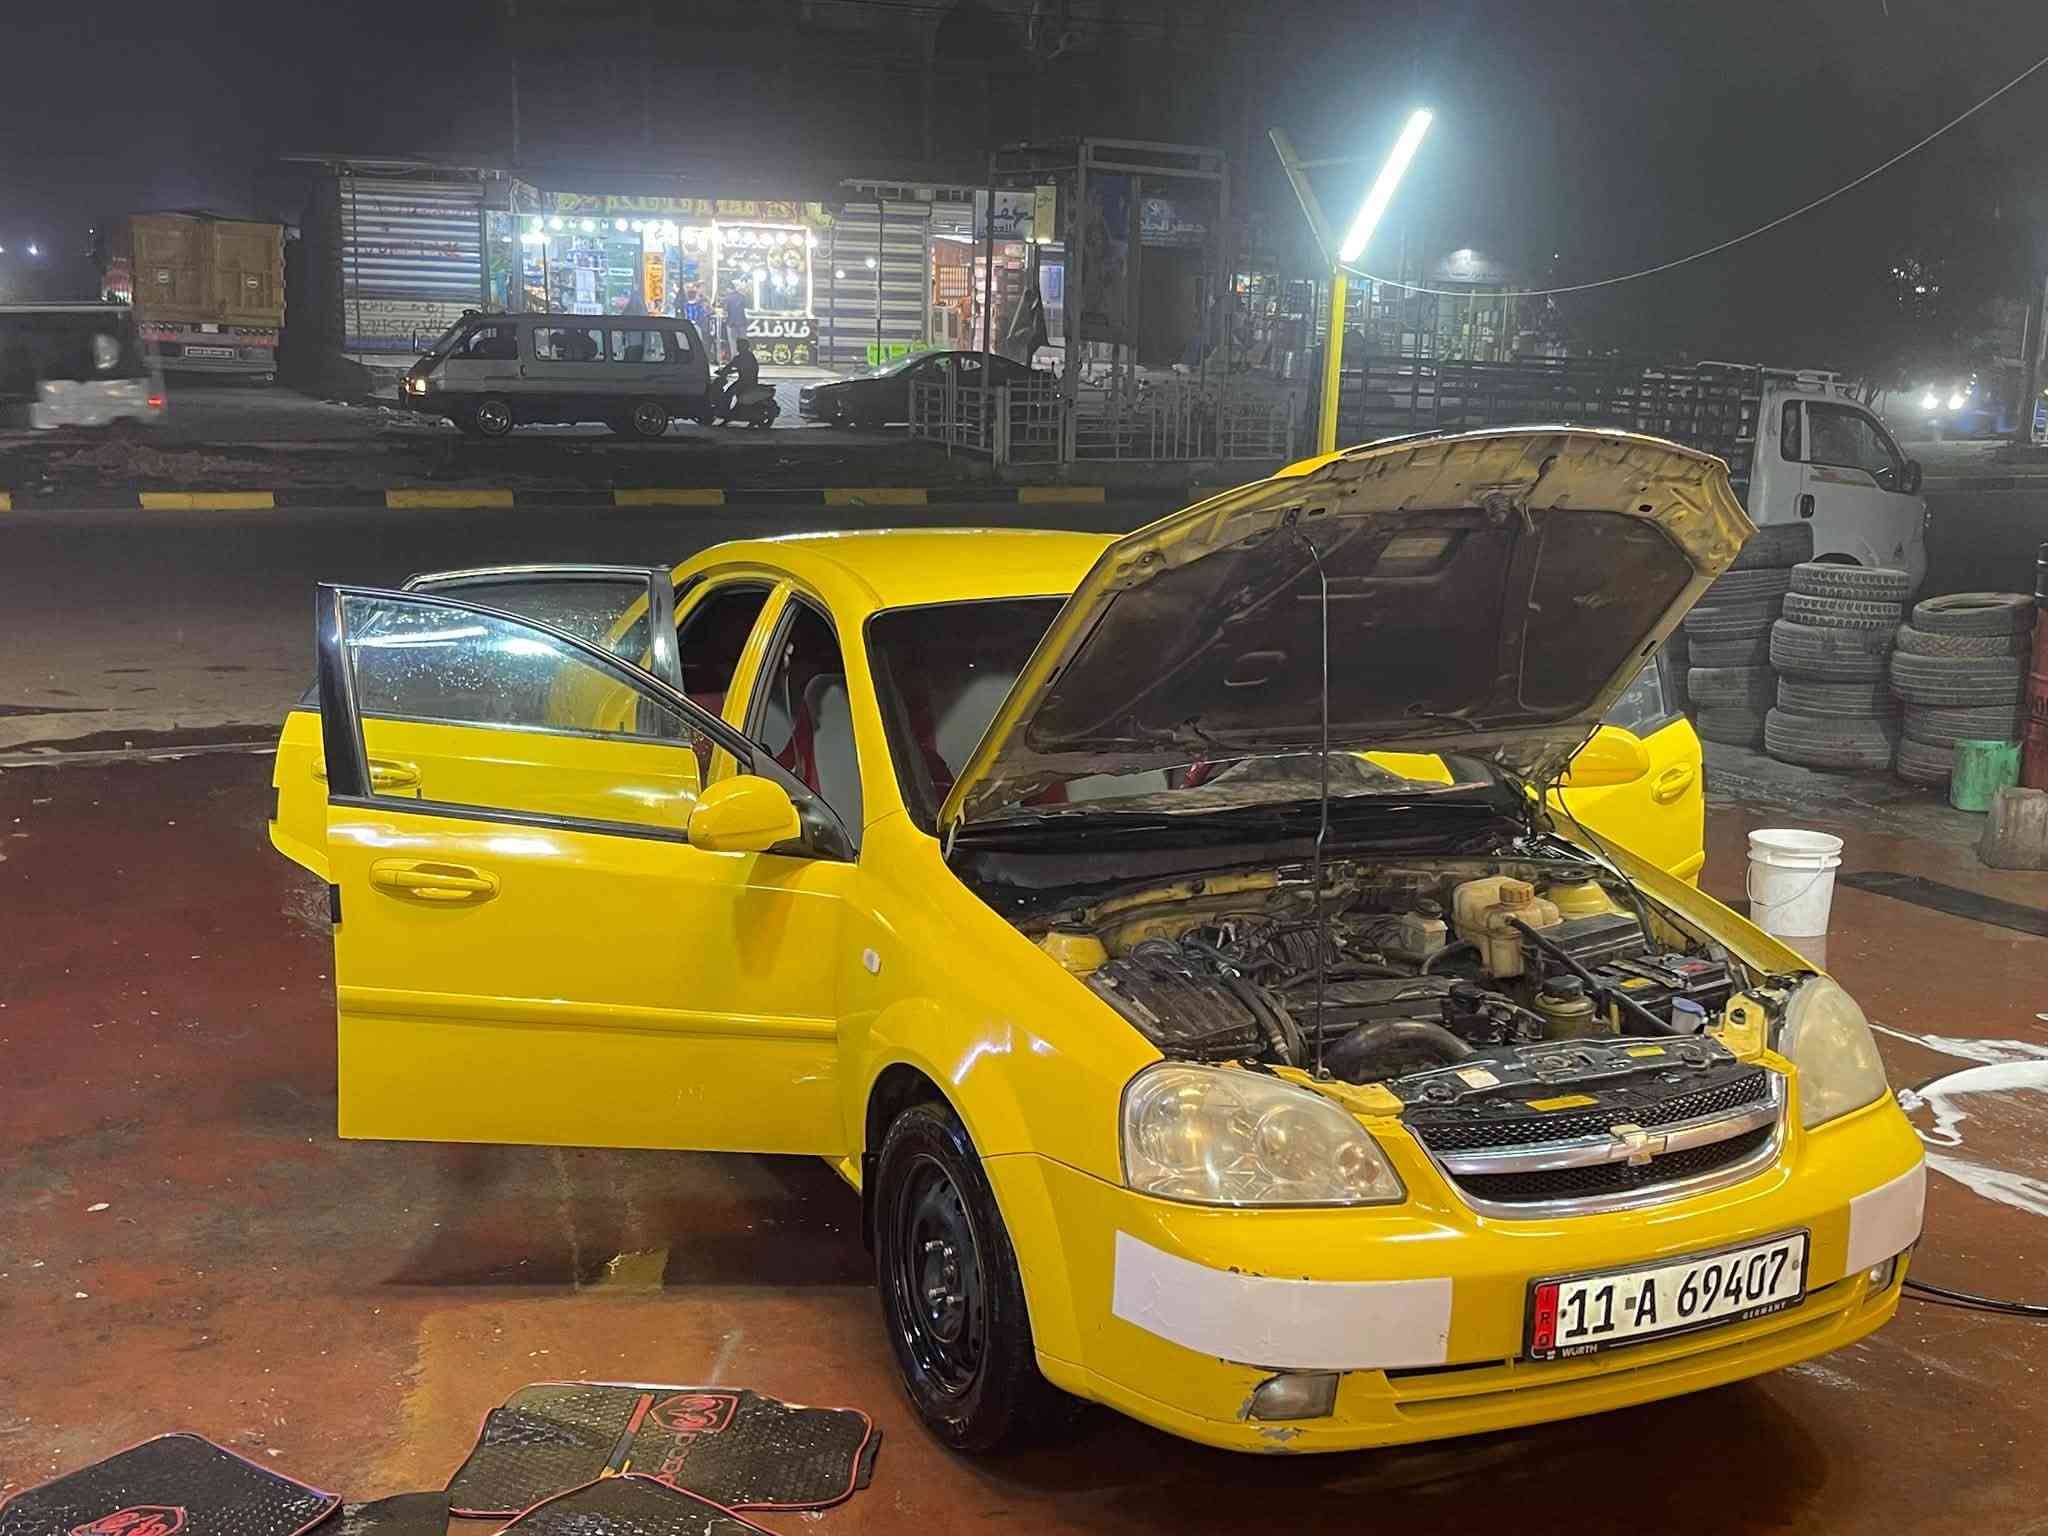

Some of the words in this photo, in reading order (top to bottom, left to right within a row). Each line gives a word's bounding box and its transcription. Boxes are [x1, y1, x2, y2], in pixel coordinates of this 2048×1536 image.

[1565, 1284, 1615, 1339] 11
[1633, 1278, 1657, 1327] A
[1676, 1247, 1789, 1317] 69407
